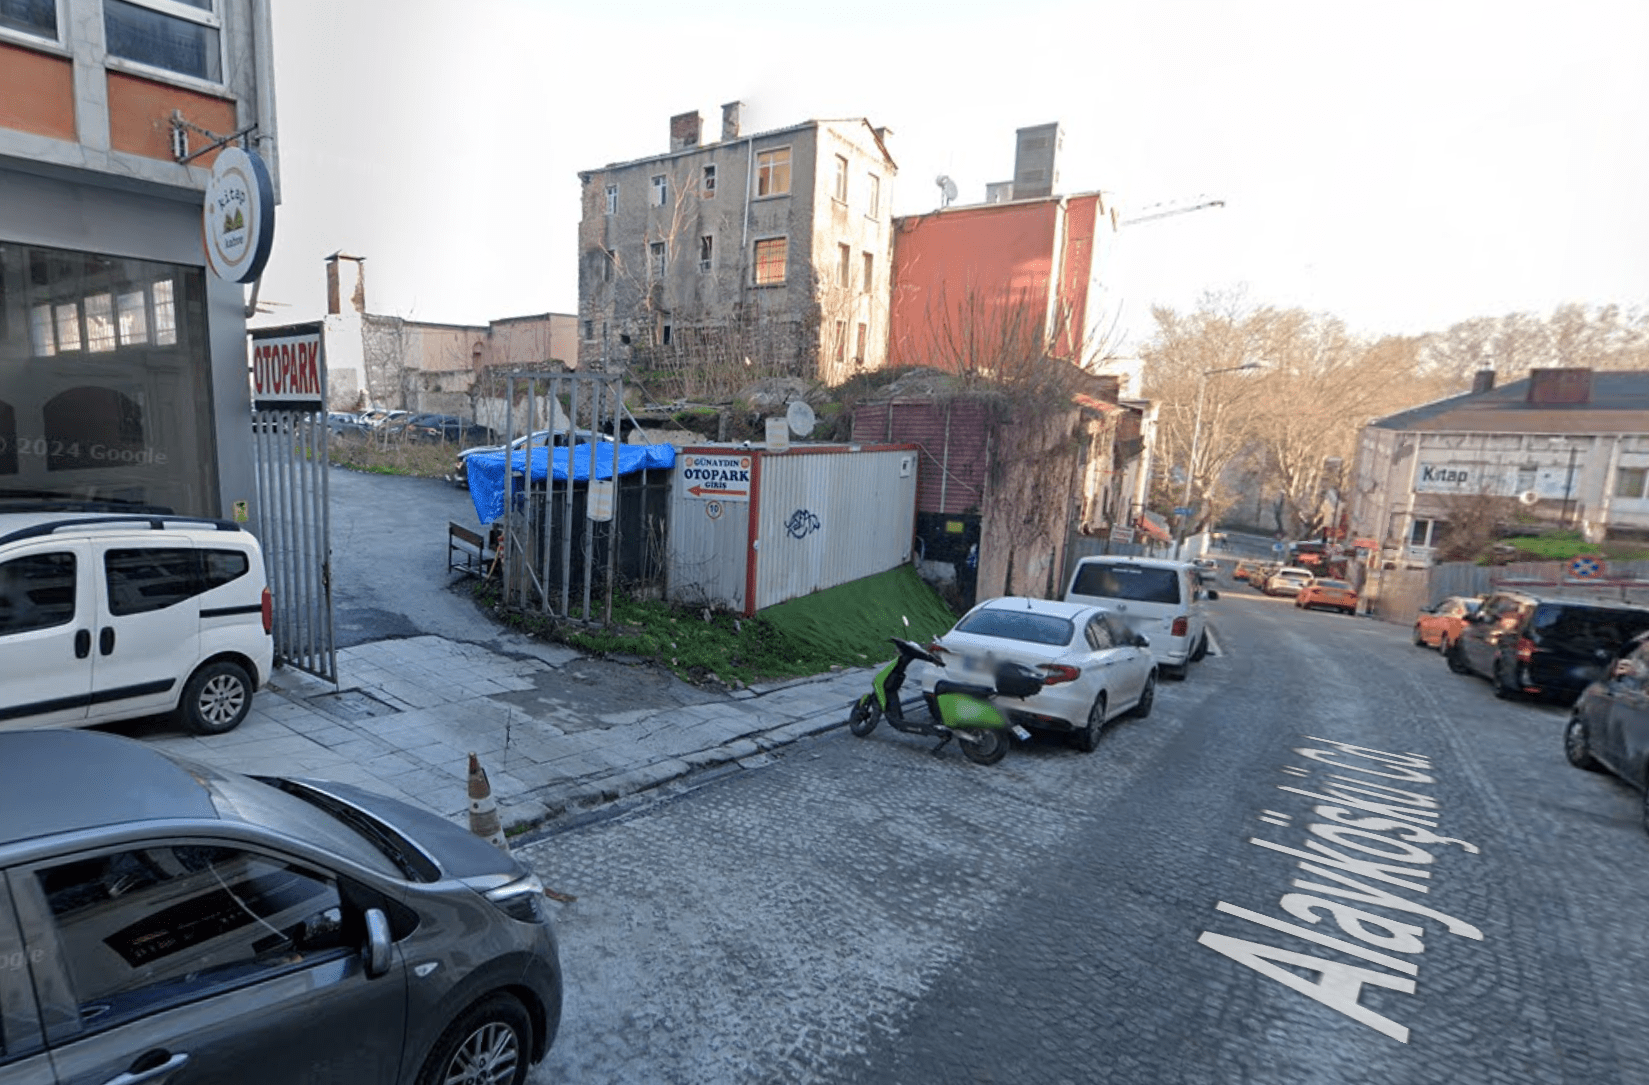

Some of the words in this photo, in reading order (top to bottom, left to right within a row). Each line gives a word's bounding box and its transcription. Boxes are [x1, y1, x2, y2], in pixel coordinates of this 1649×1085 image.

[254, 341, 320, 395] OTOPARK
[684, 468, 749, 482] OTOPARK
[709, 504, 720, 513] 10
[1197, 764, 1485, 1044] Alayköşkü
